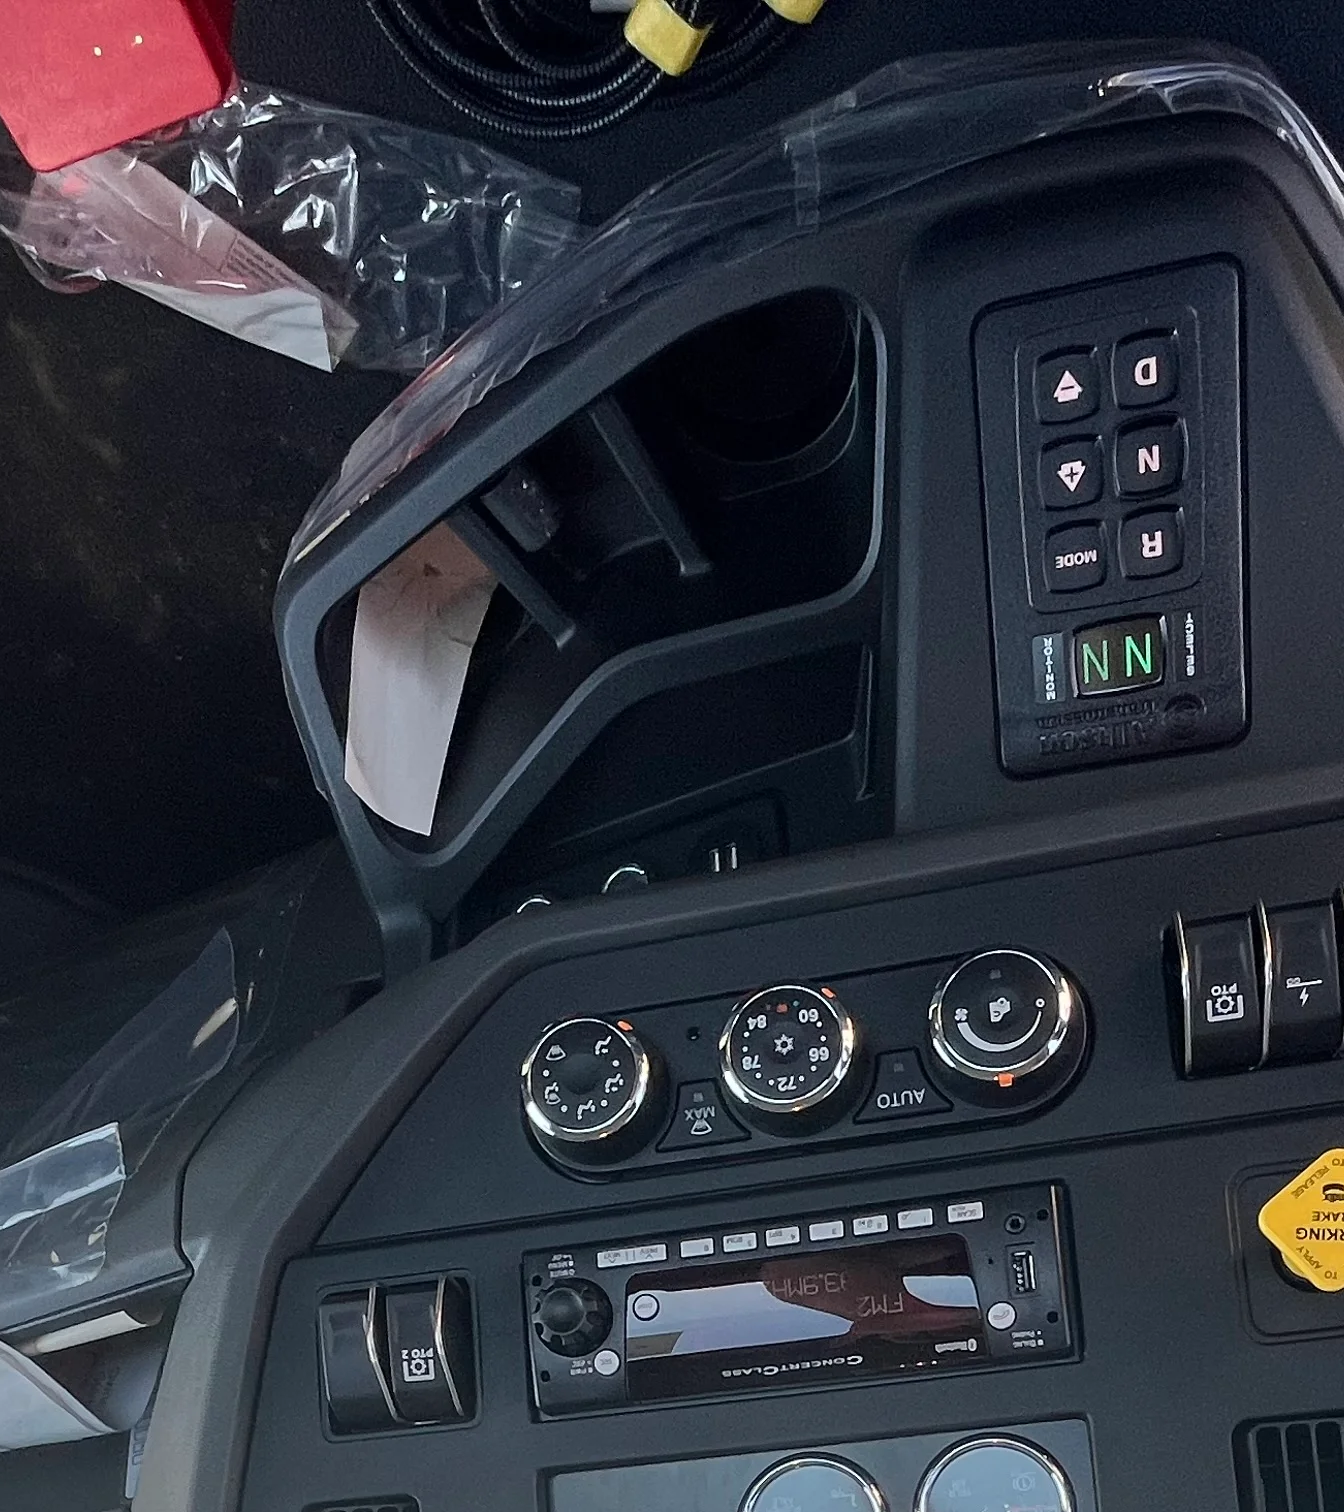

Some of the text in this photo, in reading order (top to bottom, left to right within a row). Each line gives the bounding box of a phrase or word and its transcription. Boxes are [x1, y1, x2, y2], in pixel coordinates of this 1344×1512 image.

[1134, 356, 1157, 386] D
[1138, 445, 1160, 473] N
[1141, 531, 1163, 558] R
[1054, 549, 1097, 569] MODE
[1185, 612, 1196, 677] SELECT
[1042, 637, 1057, 701] MONITOR
[1082, 633, 1152, 684] N N
[1210, 983, 1237, 996] PTO
[747, 1015, 767, 1031] 84
[798, 1008, 819, 1023] 60
[741, 1055, 762, 1071] 78
[809, 1046, 830, 1062] 66
[777, 1076, 797, 1091] 72
[877, 1087, 926, 1110] AUTO
[684, 1106, 716, 1122] MAX
[1290, 1165, 1330, 1199] RELEASE
[1296, 1246, 1323, 1269] APPLY
[1324, 1271, 1337, 1280] TO
[856, 1293, 904, 1317] FM2
[401, 1348, 433, 1359] PTO 2
